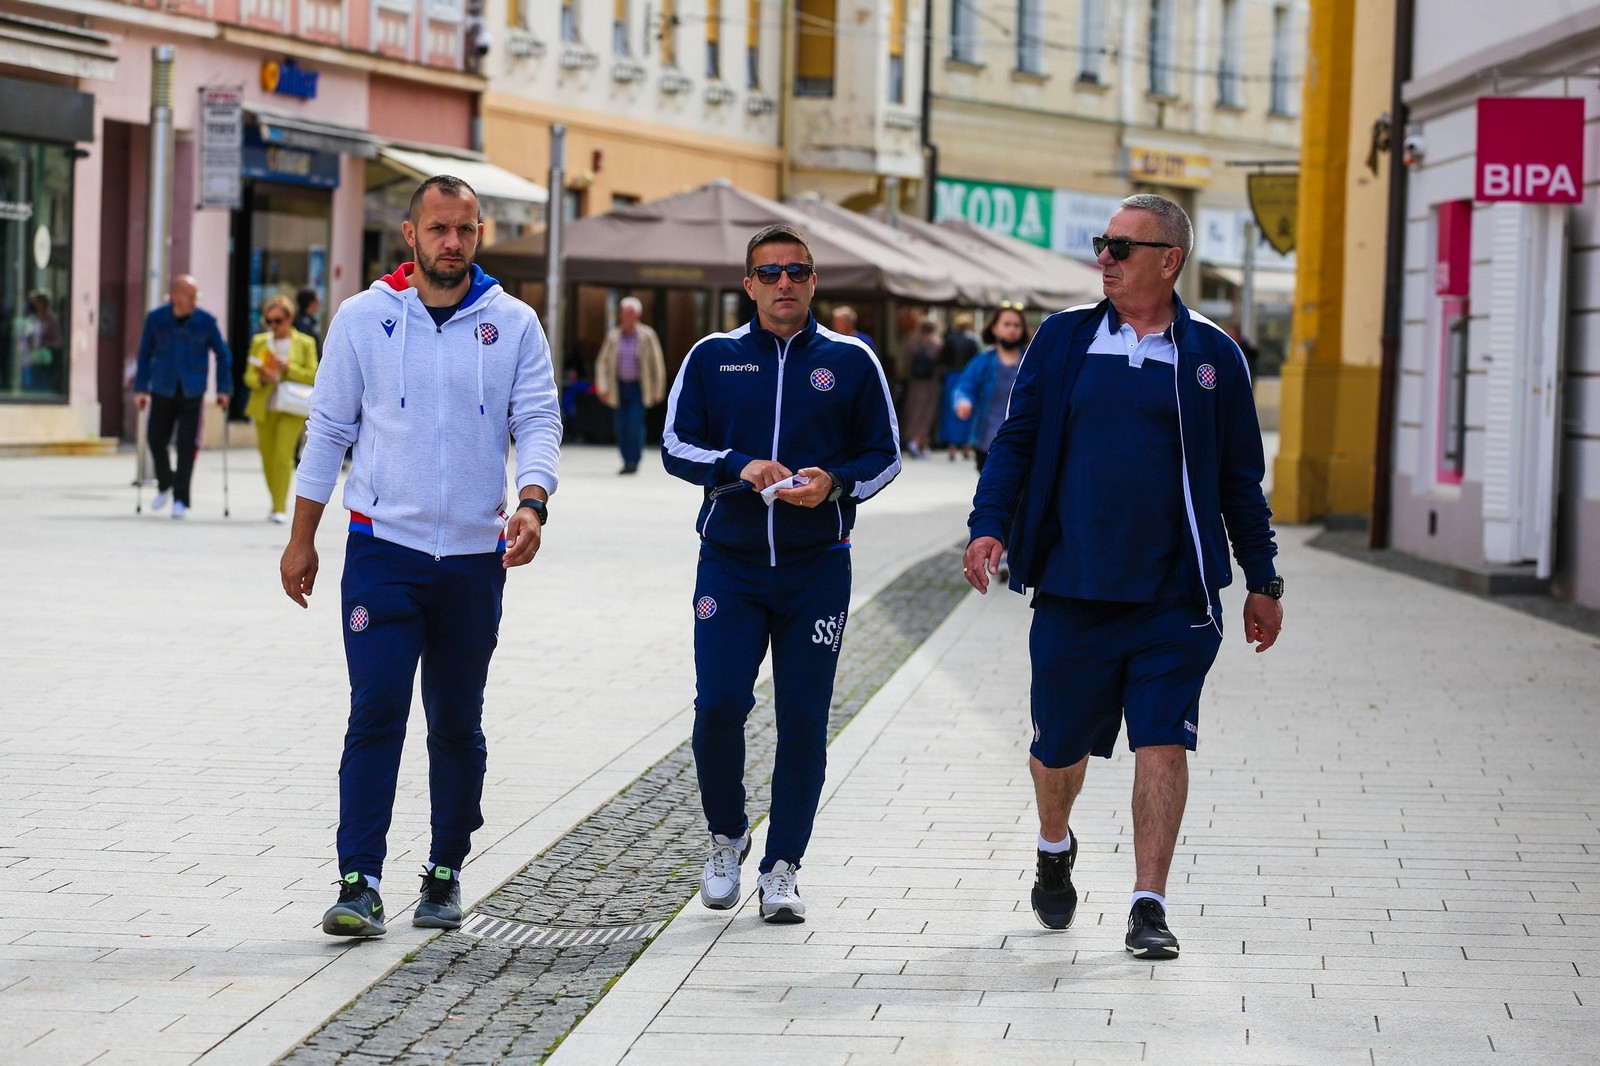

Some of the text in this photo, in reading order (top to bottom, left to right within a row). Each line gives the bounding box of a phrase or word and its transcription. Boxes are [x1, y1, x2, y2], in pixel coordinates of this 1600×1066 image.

[1483, 163, 1577, 197] BIPA
[935, 180, 1046, 241] MODA
[719, 363, 759, 372] macron
[832, 611, 845, 652] macron
